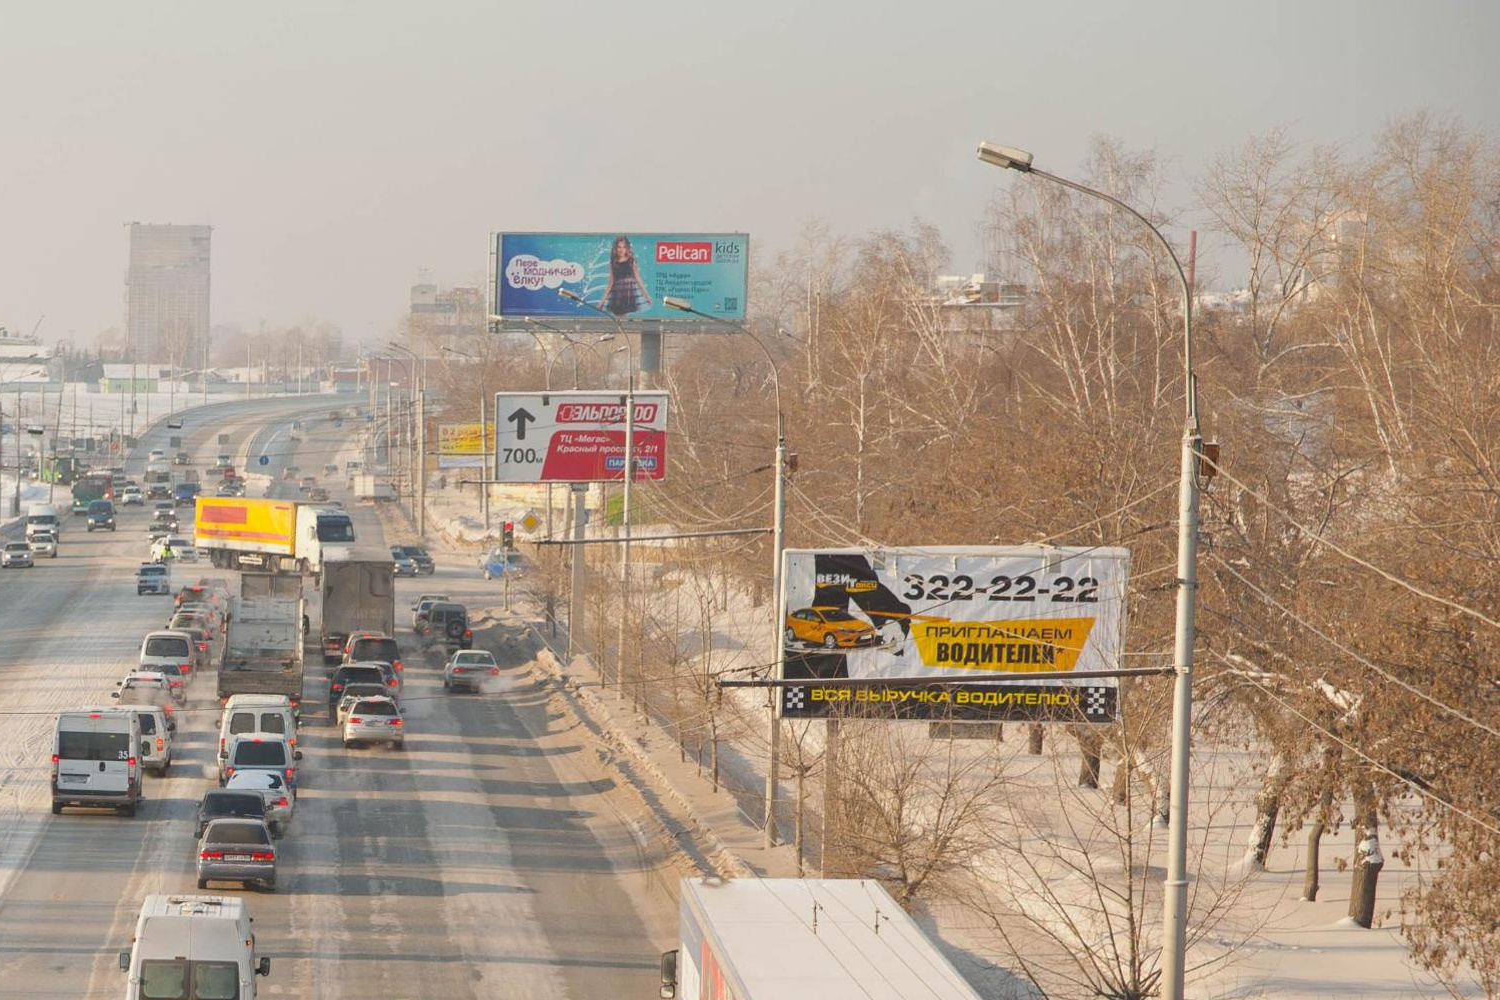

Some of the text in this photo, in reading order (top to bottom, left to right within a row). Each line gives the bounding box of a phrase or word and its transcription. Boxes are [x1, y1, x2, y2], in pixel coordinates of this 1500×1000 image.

[659, 241, 739, 260] Pelican kids
[516, 259, 538, 268] Пере
[524, 265, 576, 276] модничай
[571, 405, 654, 421] ЭЛЬДОРДО
[560, 434, 573, 444] ТЦ
[557, 444, 598, 453] Красный
[645, 445, 658, 453] 2/1
[903, 574, 1099, 603] 322-22-22
[925, 625, 1073, 640] ПРИГЛАШАЕМ
[811, 689, 851, 701] ВСЯ
[855, 690, 950, 703] ВЫРУЧКА
[117, 750, 128, 759] 35
